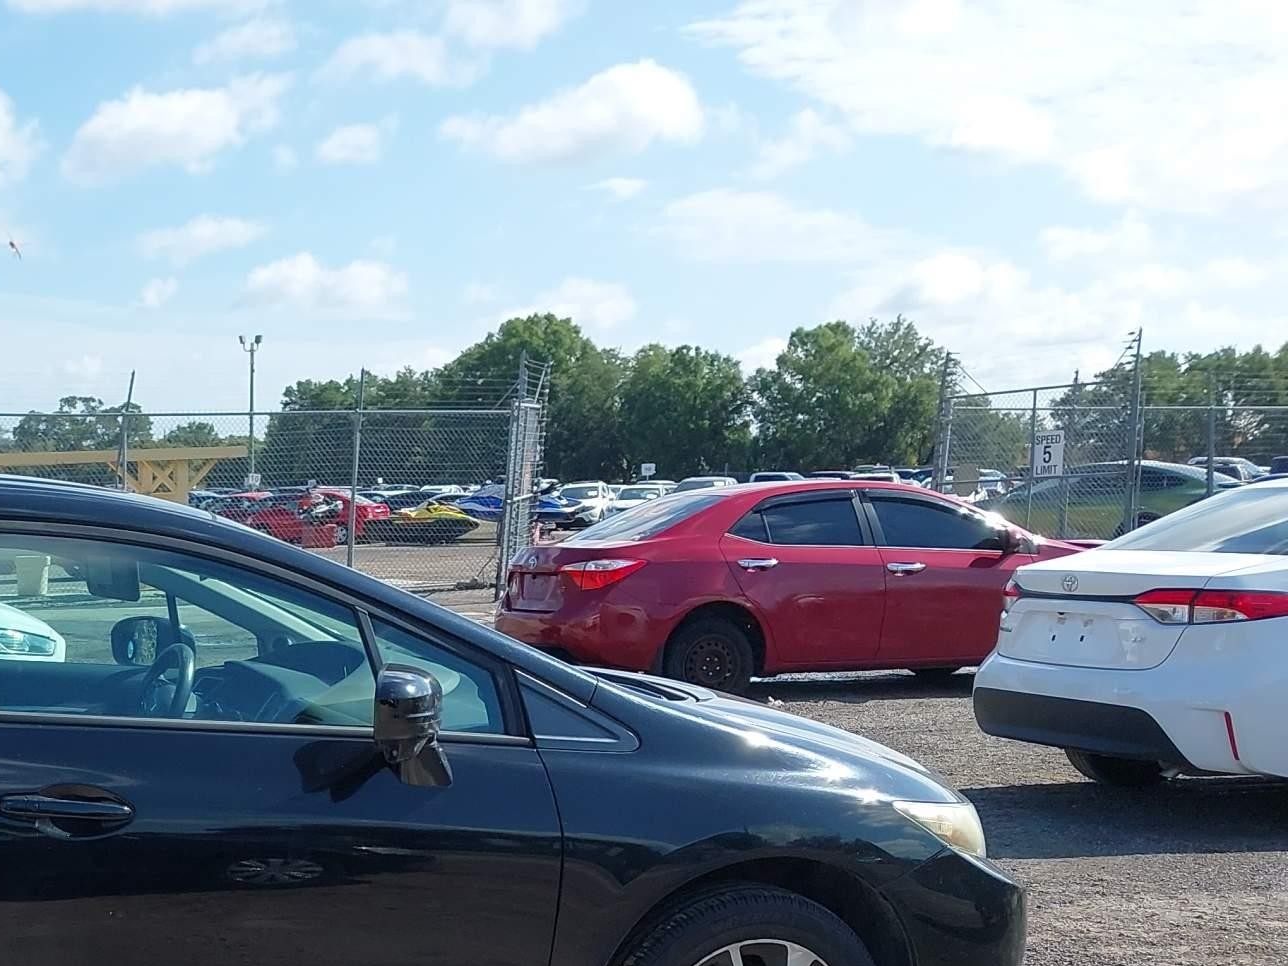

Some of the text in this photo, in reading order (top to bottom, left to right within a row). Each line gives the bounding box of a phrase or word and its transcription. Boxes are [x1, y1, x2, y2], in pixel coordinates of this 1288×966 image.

[1036, 434, 1060, 445] SPEED
[1043, 445, 1051, 463] 5
[1036, 465, 1057, 475] LIMIT
